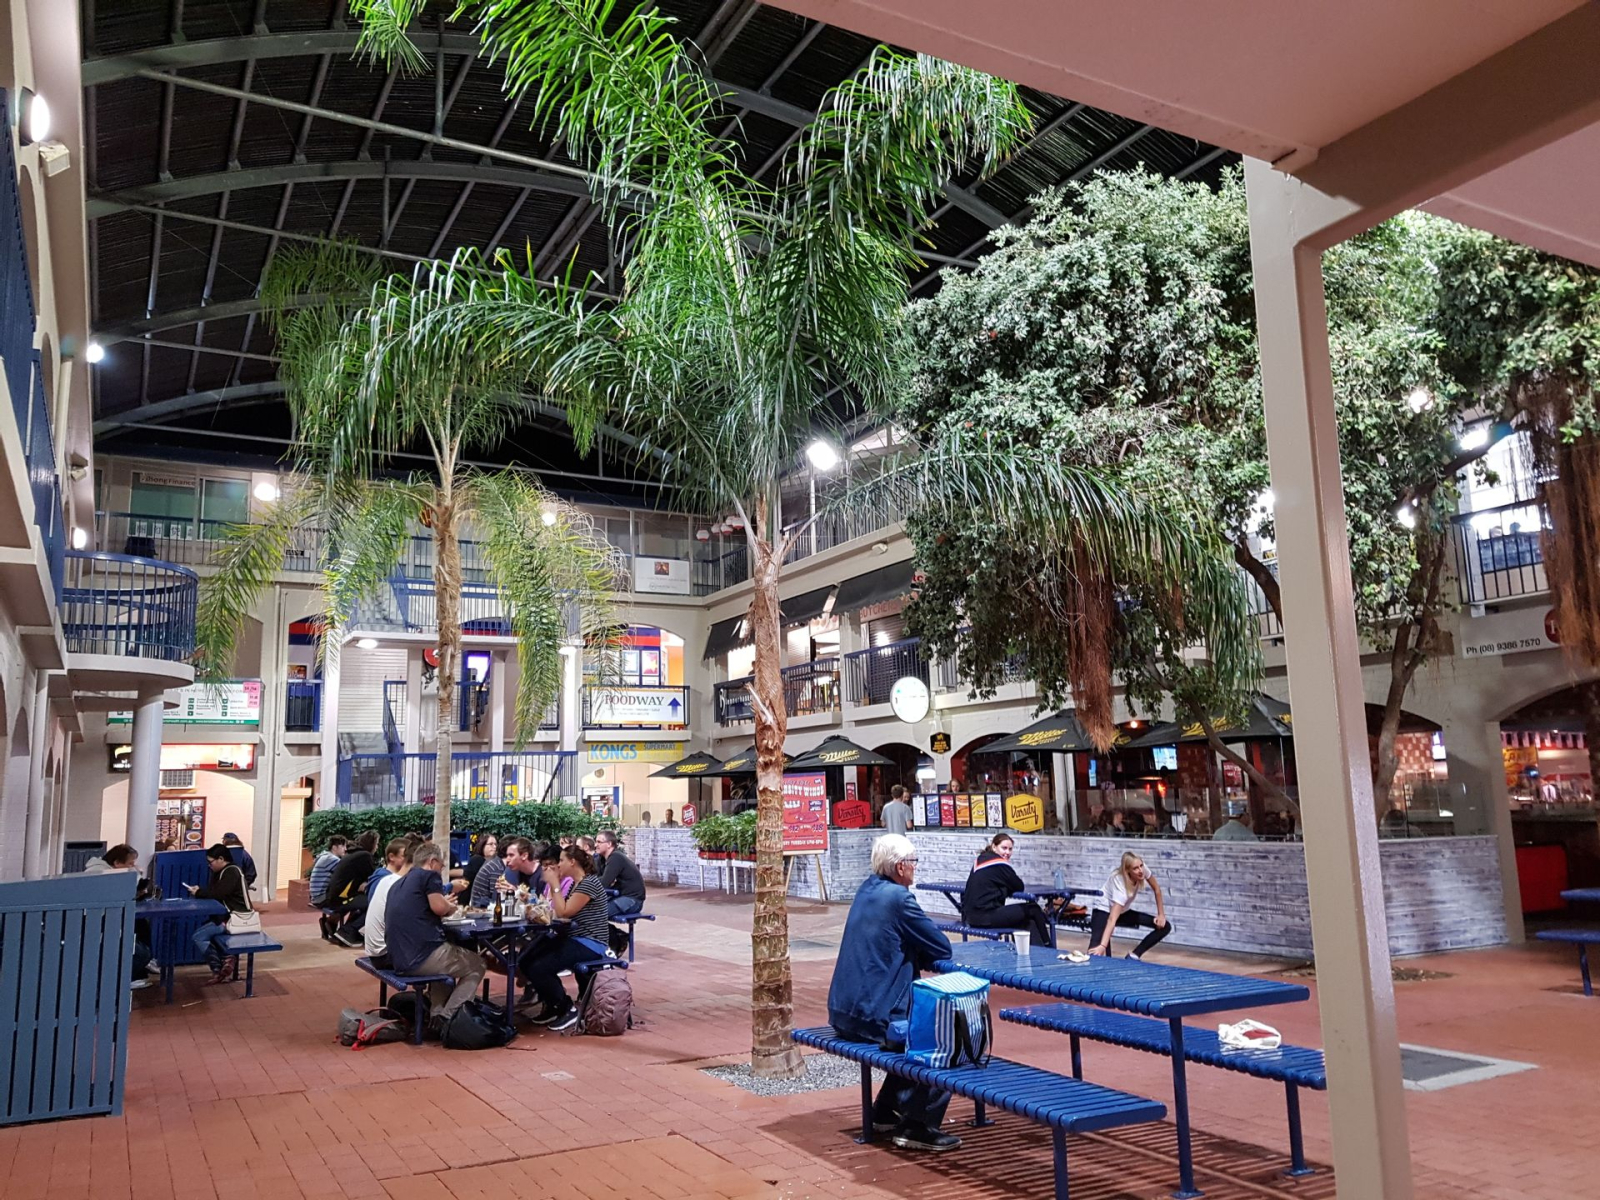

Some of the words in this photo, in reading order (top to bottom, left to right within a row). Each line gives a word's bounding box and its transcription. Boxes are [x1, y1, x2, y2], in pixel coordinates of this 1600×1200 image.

[605, 695, 664, 705] FOODWAY
[590, 744, 637, 760] KONGS
[819, 750, 858, 763] Miller
[1011, 802, 1039, 825] Varsity
